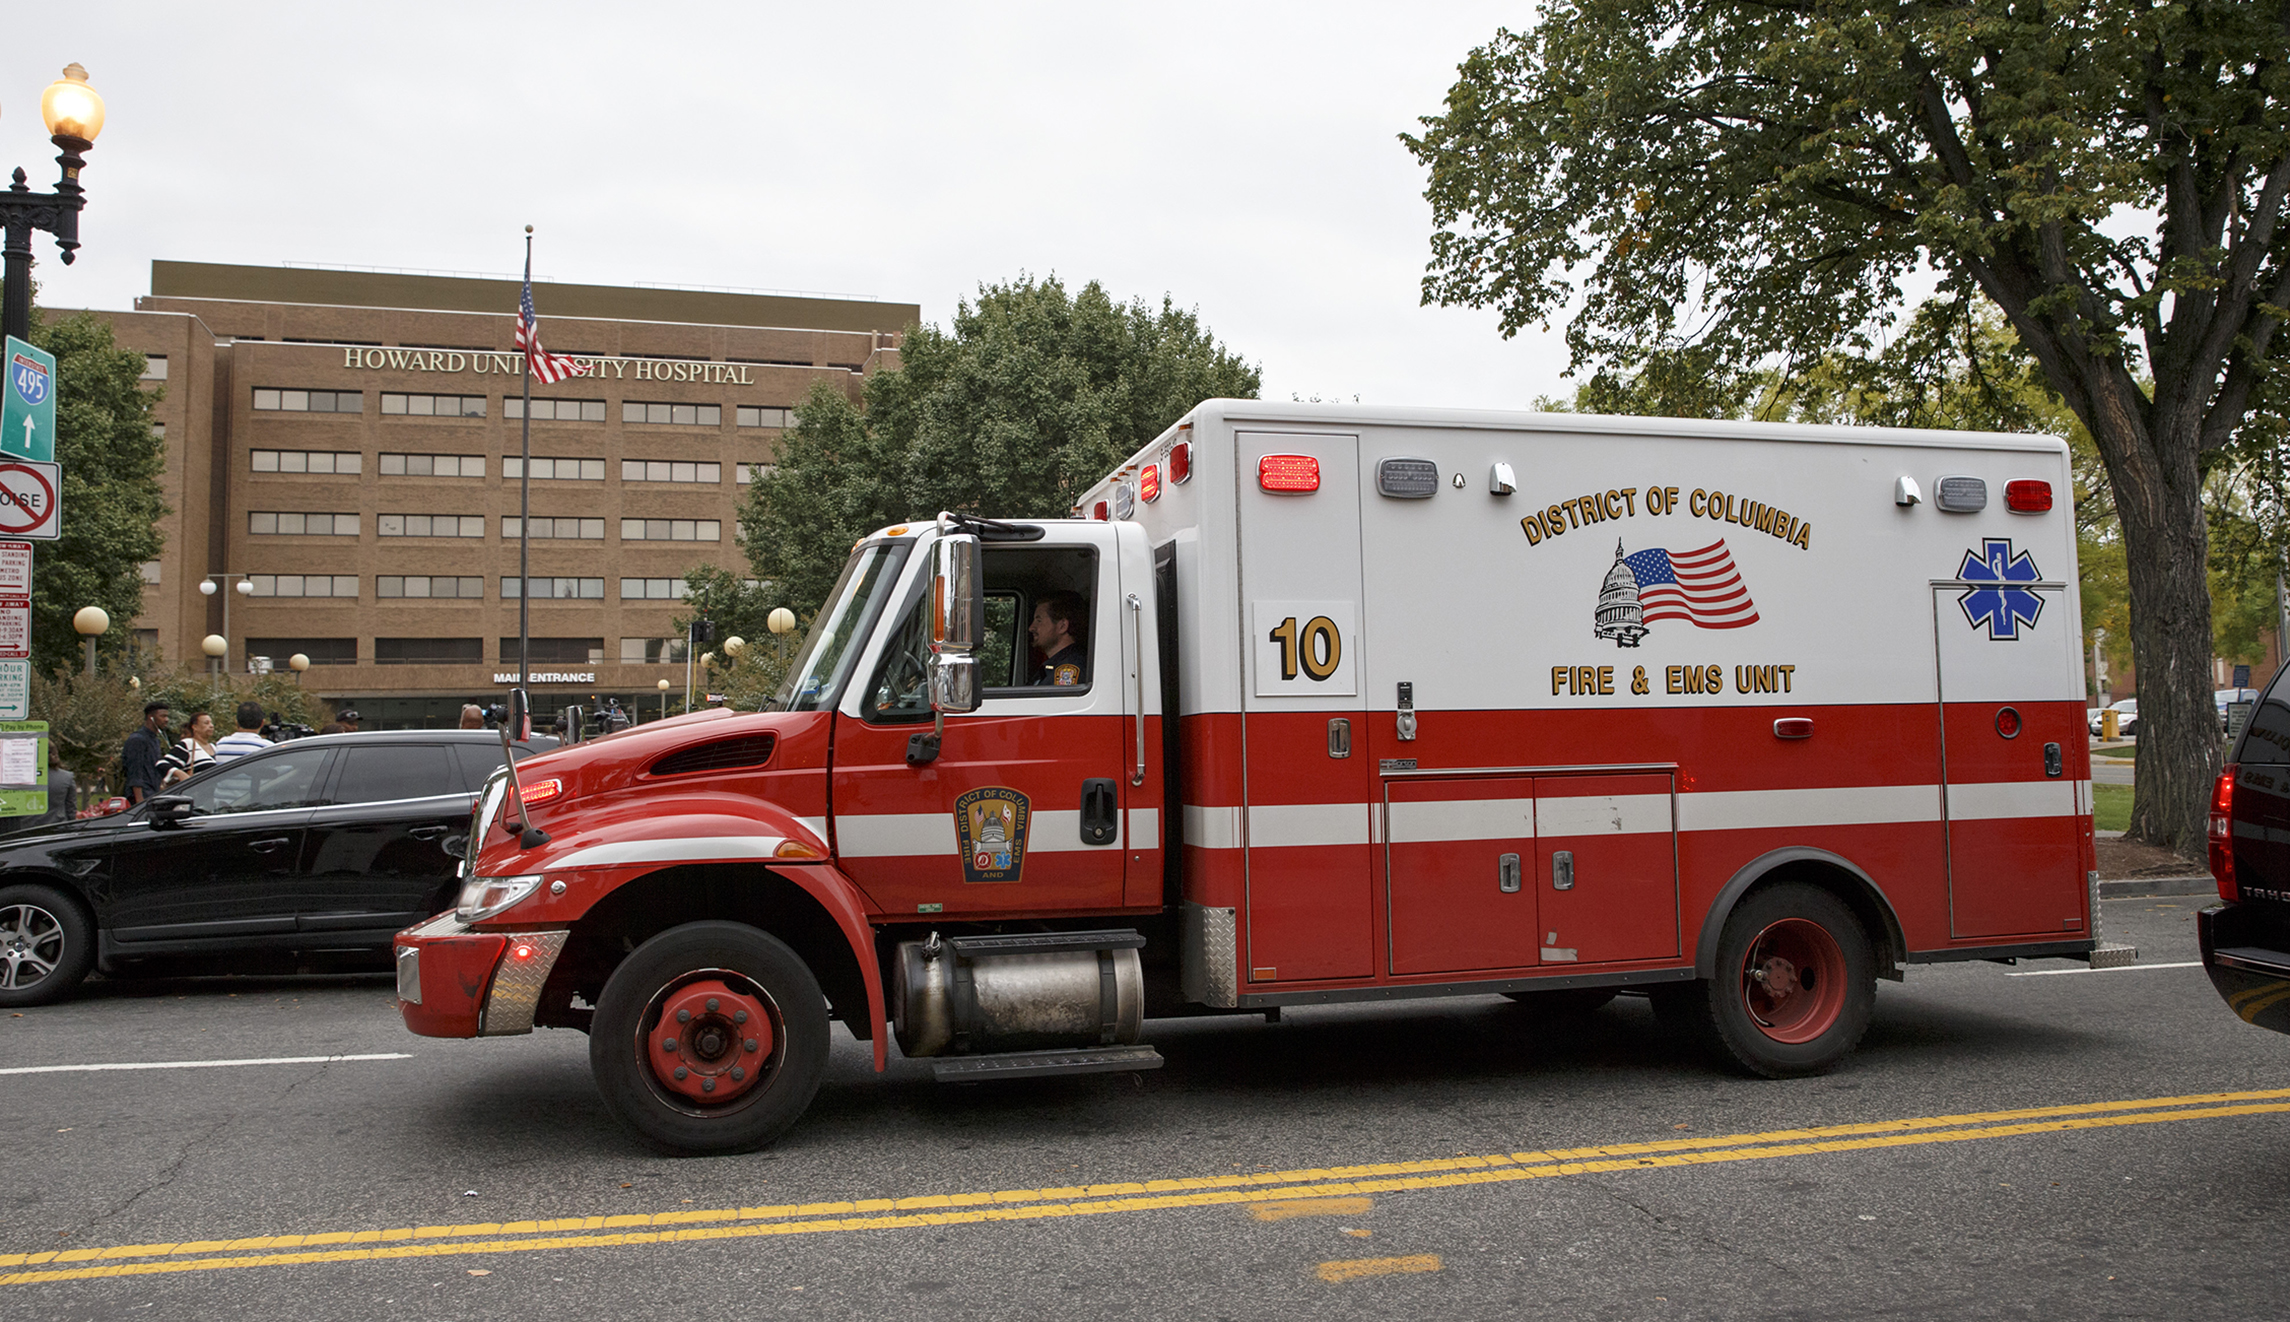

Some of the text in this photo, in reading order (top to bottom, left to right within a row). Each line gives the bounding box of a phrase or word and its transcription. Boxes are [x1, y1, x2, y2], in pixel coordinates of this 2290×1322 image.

[344, 348, 755, 385] HOWARD UNISITY HOSPITAL
[18, 368, 44, 399] 495
[0, 492, 41, 507] OISE
[1520, 486, 1811, 551] DISTRICT OF COLUMBIA
[1269, 615, 1342, 682] 10
[493, 672, 595, 683] MAI ENTRANCE
[1551, 664, 1796, 696] FIRE & EMS UNIT
[958, 790, 1026, 833] DISTRICT OF COLUMBIA
[962, 840, 972, 864] FIRE
[1013, 838, 1022, 863] EMS
[2243, 886, 2290, 902] TAHO
